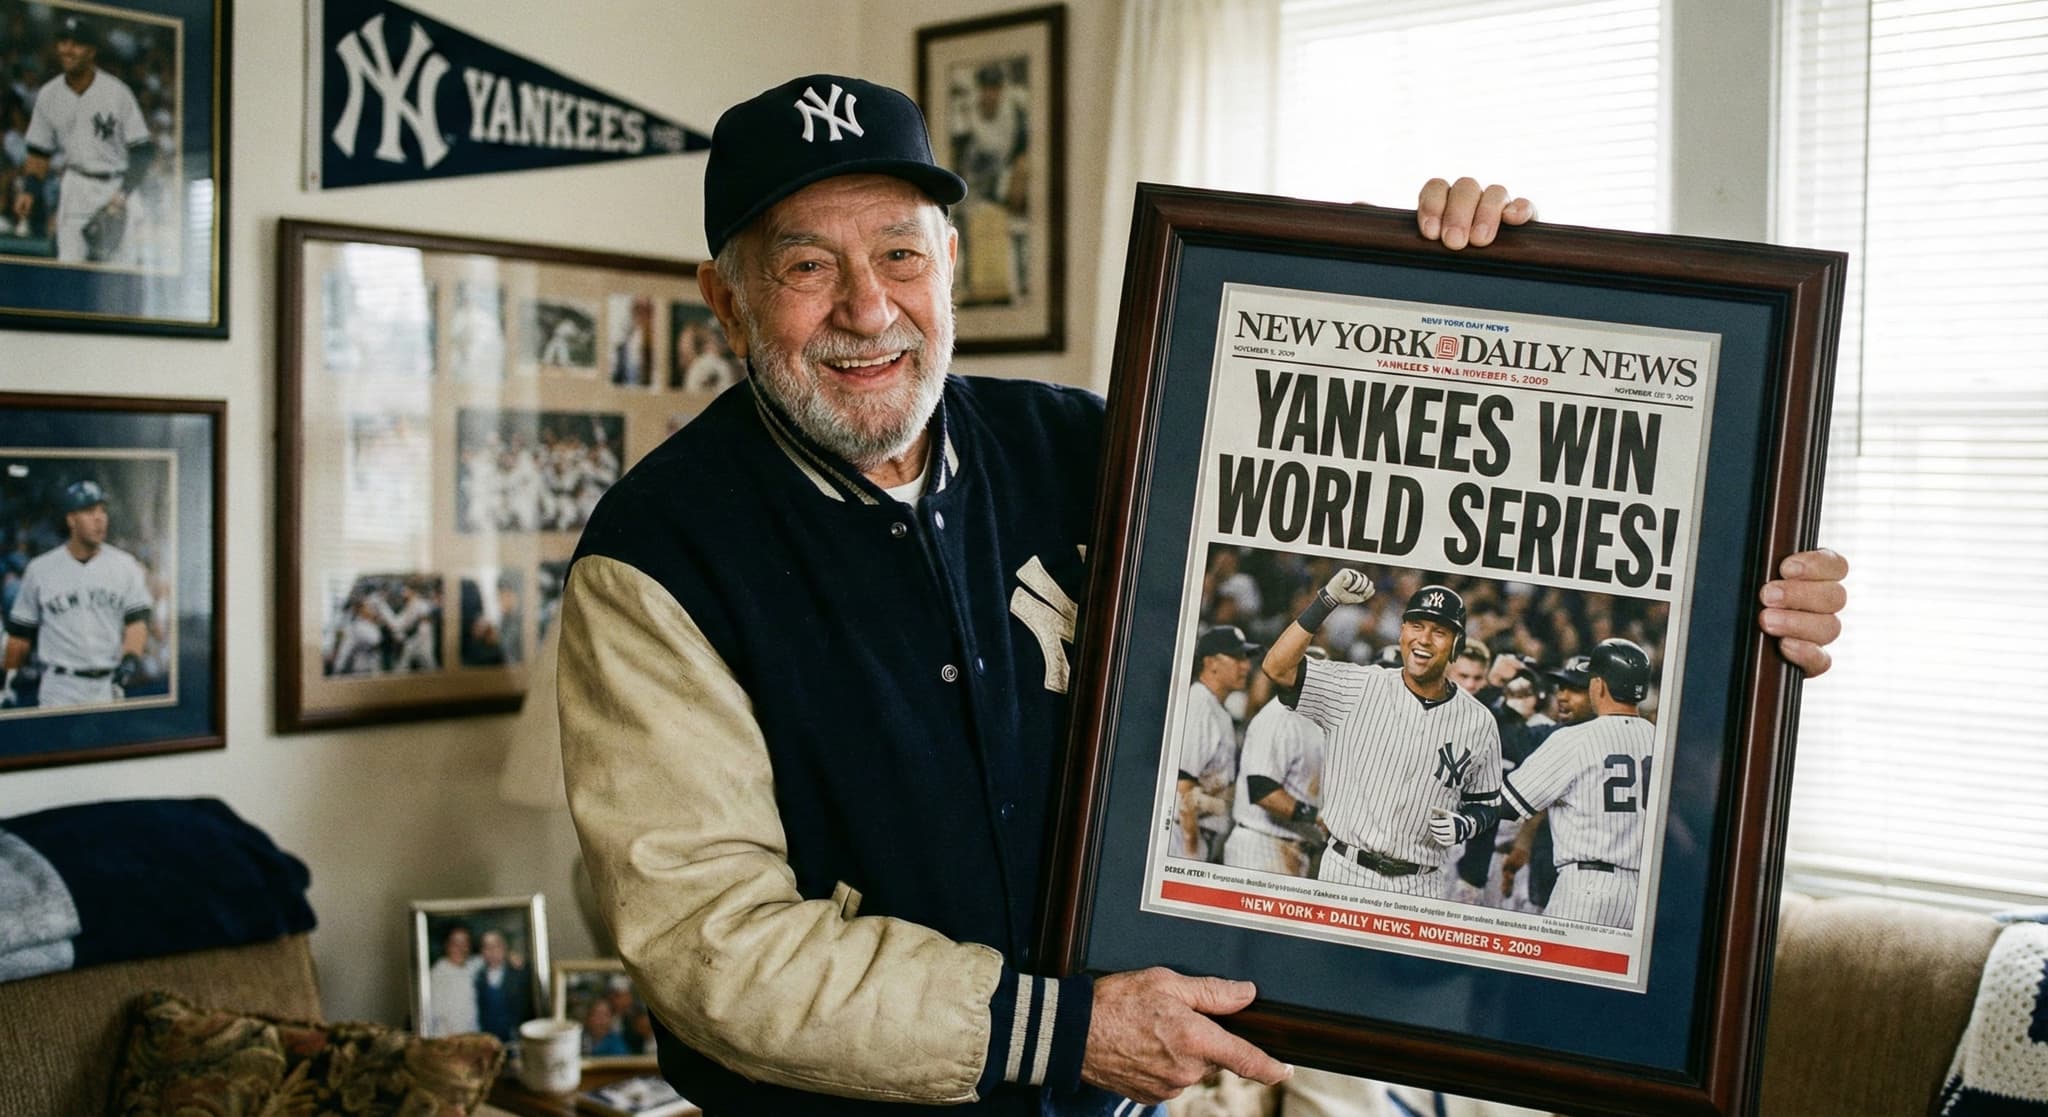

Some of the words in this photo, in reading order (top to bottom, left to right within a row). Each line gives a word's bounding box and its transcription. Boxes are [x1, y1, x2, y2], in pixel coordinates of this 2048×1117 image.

[331, 13, 450, 170] NY
[462, 67, 647, 153] YANKEES
[794, 83, 864, 143] NY
[1235, 310, 1327, 347] NEW
[1332, 321, 1437, 360] YORK
[1457, 334, 1575, 374] DAILY
[1579, 347, 1698, 388] NEWS
[1444, 318, 1465, 329] YORK
[1485, 323, 1510, 333] NEWS
[1522, 375, 1550, 386] 2009
[1254, 368, 1515, 478] YANKEES
[1538, 400, 1662, 496] WIN
[1218, 453, 1424, 557] WORLD
[1443, 482, 1681, 592] SERIES!
[1434, 742, 1472, 789] NY
[1278, 901, 1314, 919] YORK
[1330, 911, 1369, 928] DAILY
[1372, 919, 1415, 938] NEWS,
[1419, 926, 1490, 950] NOVEMBER
[1491, 937, 1504, 952] 5,
[1508, 940, 1542, 957] 2009
